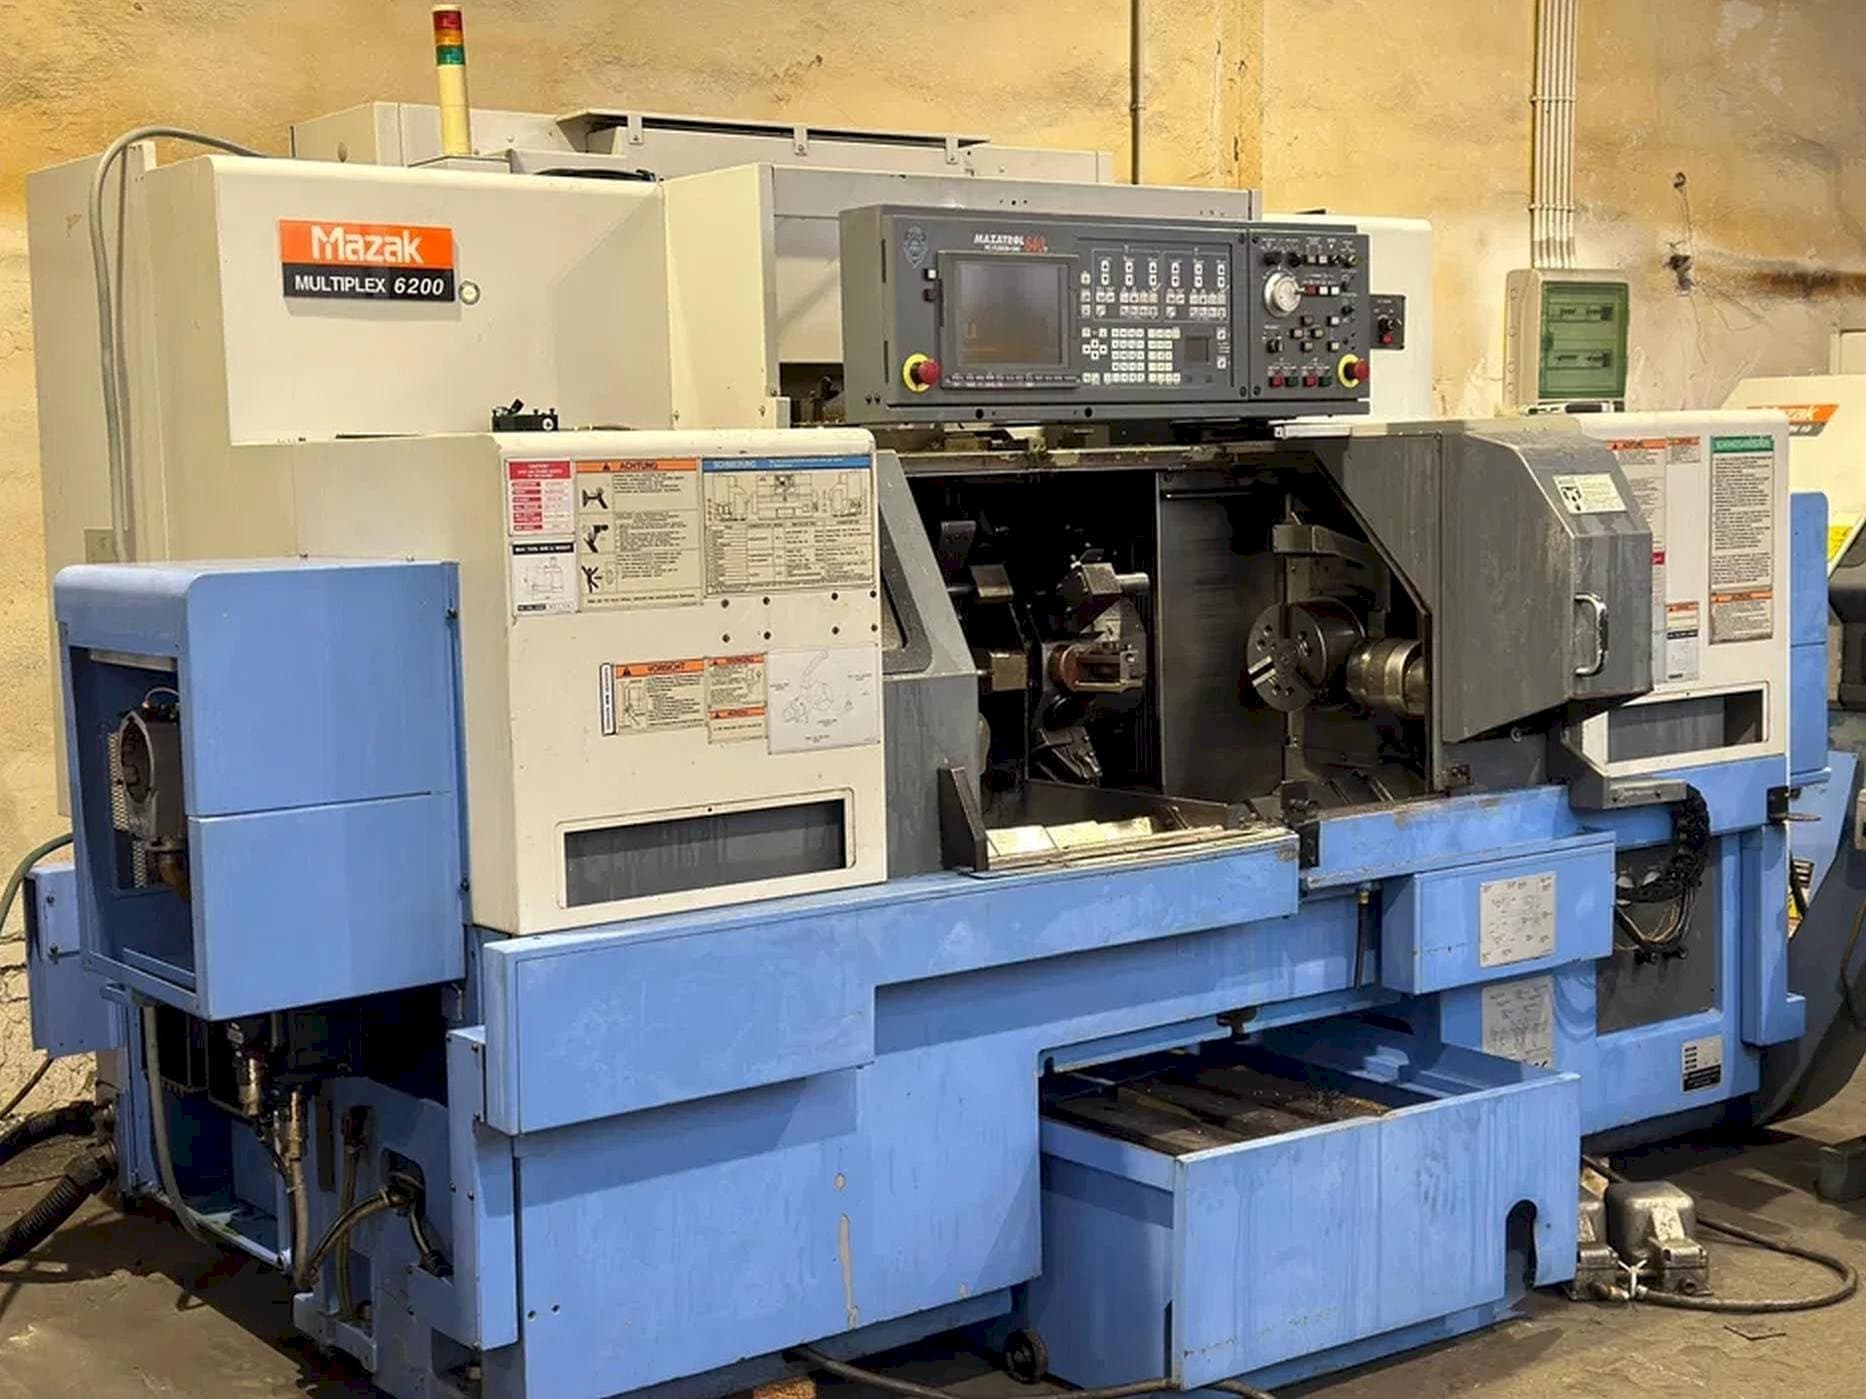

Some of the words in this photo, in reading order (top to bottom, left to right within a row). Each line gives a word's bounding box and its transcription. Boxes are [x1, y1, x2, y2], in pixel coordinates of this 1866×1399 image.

[310, 225, 424, 263] Mazak
[295, 275, 386, 293] MULTIPLEX
[393, 278, 444, 295] 6200
